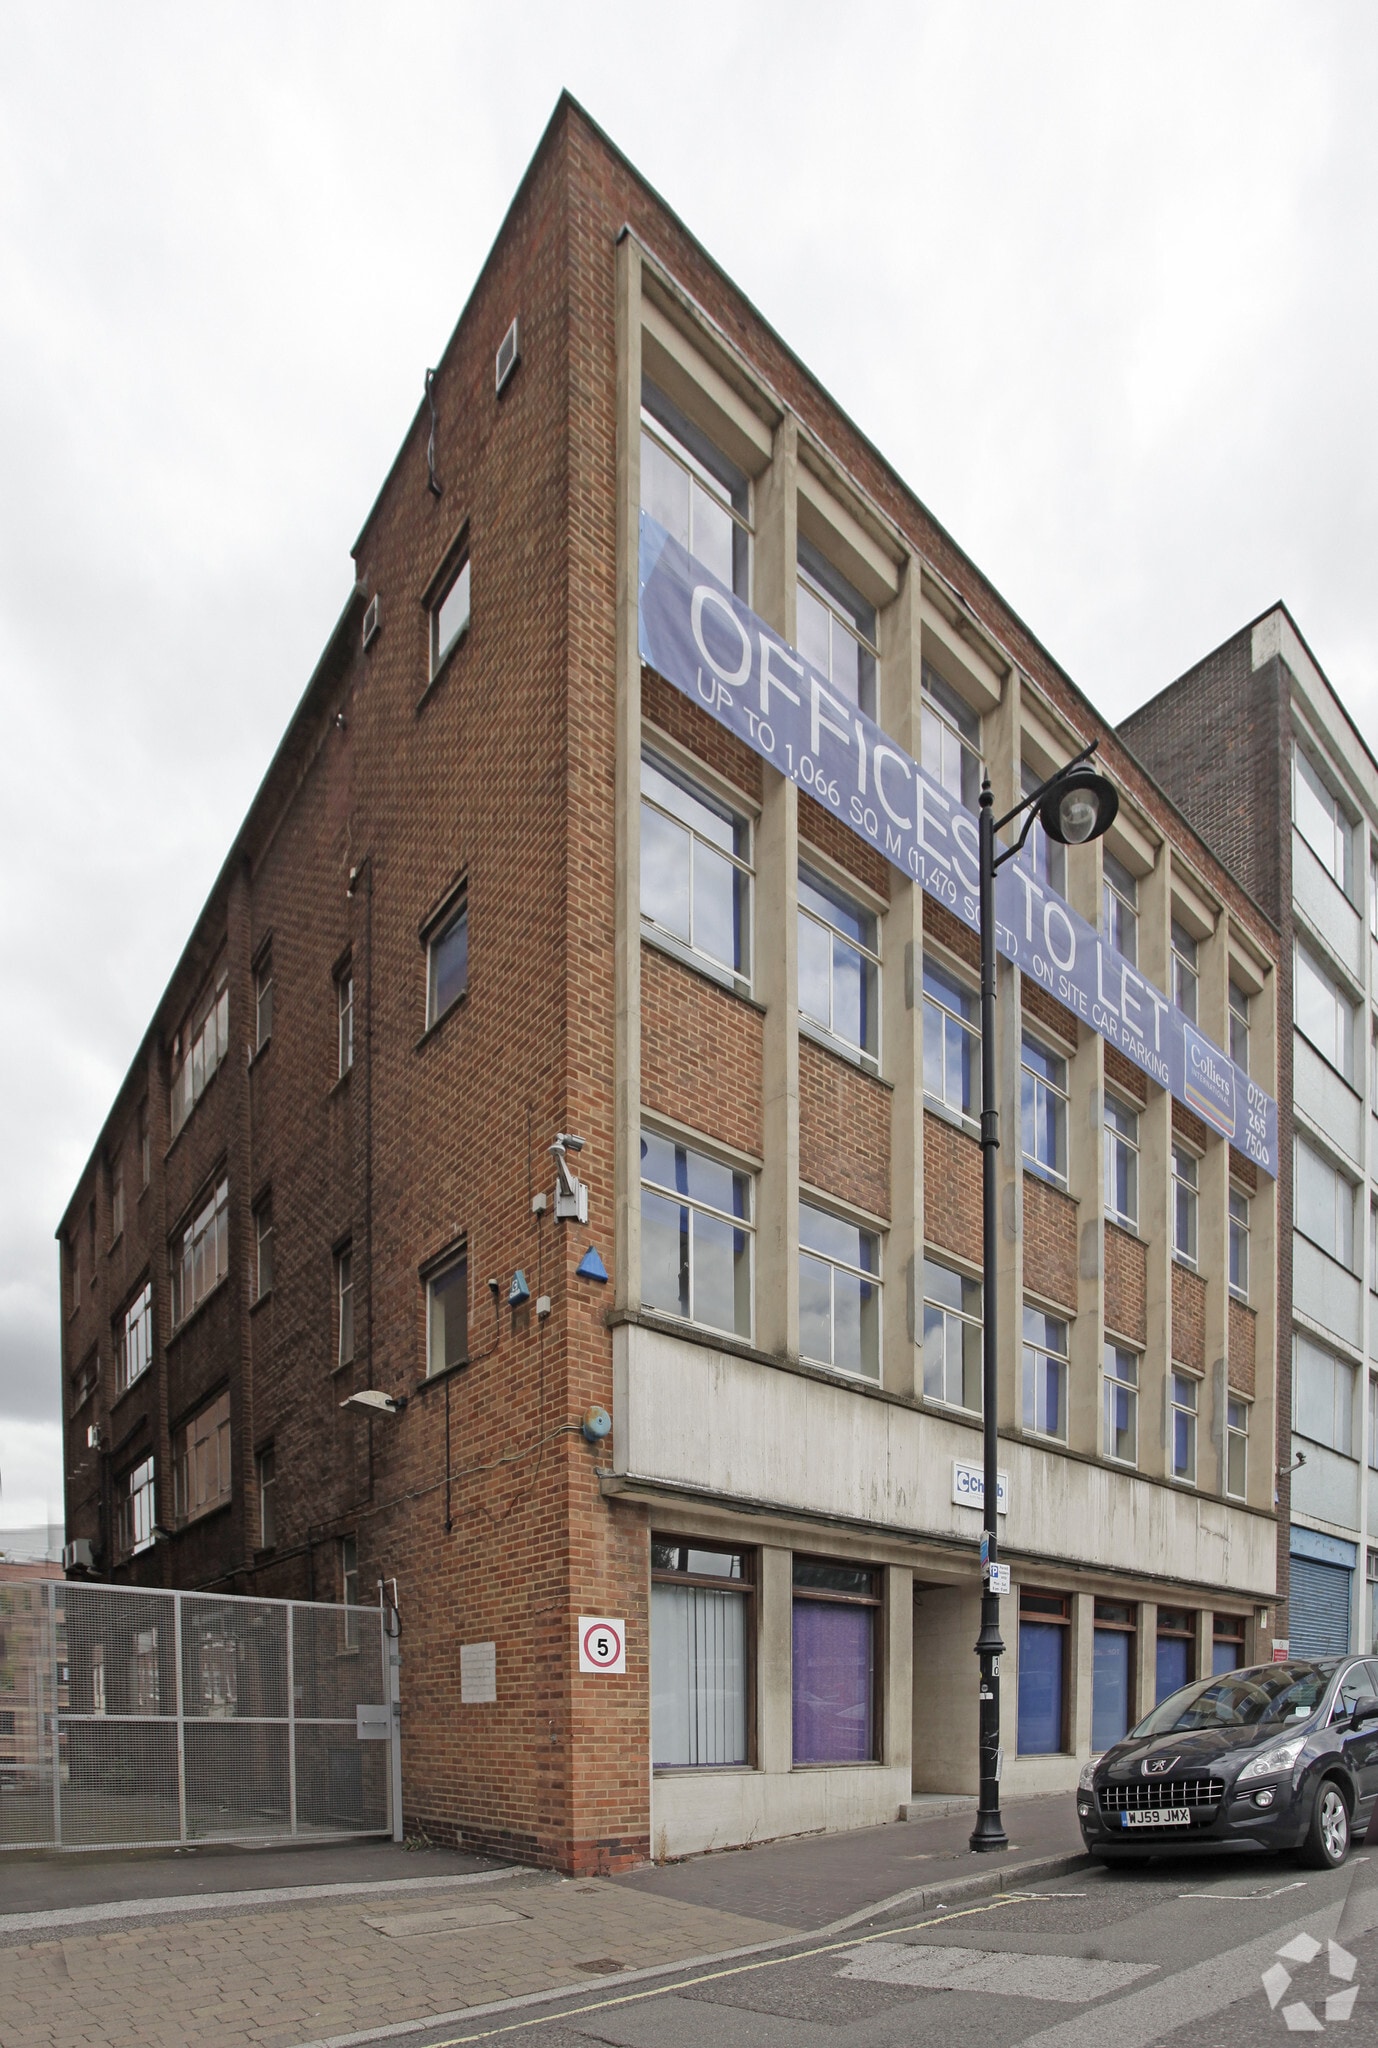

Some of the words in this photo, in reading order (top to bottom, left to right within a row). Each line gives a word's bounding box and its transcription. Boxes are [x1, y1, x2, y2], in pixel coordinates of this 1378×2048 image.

[691, 584, 980, 897] OFFICES
[1012, 863, 1077, 972] TO
[1096, 940, 1169, 1053] LET
[697, 666, 734, 712] UP
[743, 706, 775, 753] TO
[785, 743, 841, 807] 1,066
[850, 795, 878, 840] SQ
[885, 823, 902, 859] M
[908, 846, 957, 904] (11,479
[1032, 954, 1054, 987] ON
[1058, 974, 1088, 1016] SITE
[1092, 1003, 1118, 1041] CAR
[1121, 1027, 1169, 1084] PARKING
[1191, 1044, 1230, 1096] Colliers
[1191, 1067, 1230, 1108] INTERNATIONAL
[1247, 1082, 1268, 1118] 0121
[1248, 1108, 1266, 1139] 265
[1245, 1128, 1270, 1165] 7500
[970, 1476, 1004, 1498] Chb
[597, 1638, 608, 1656] 5
[1128, 1811, 1160, 1823] WJ59
[1164, 1809, 1188, 1821] JMX
